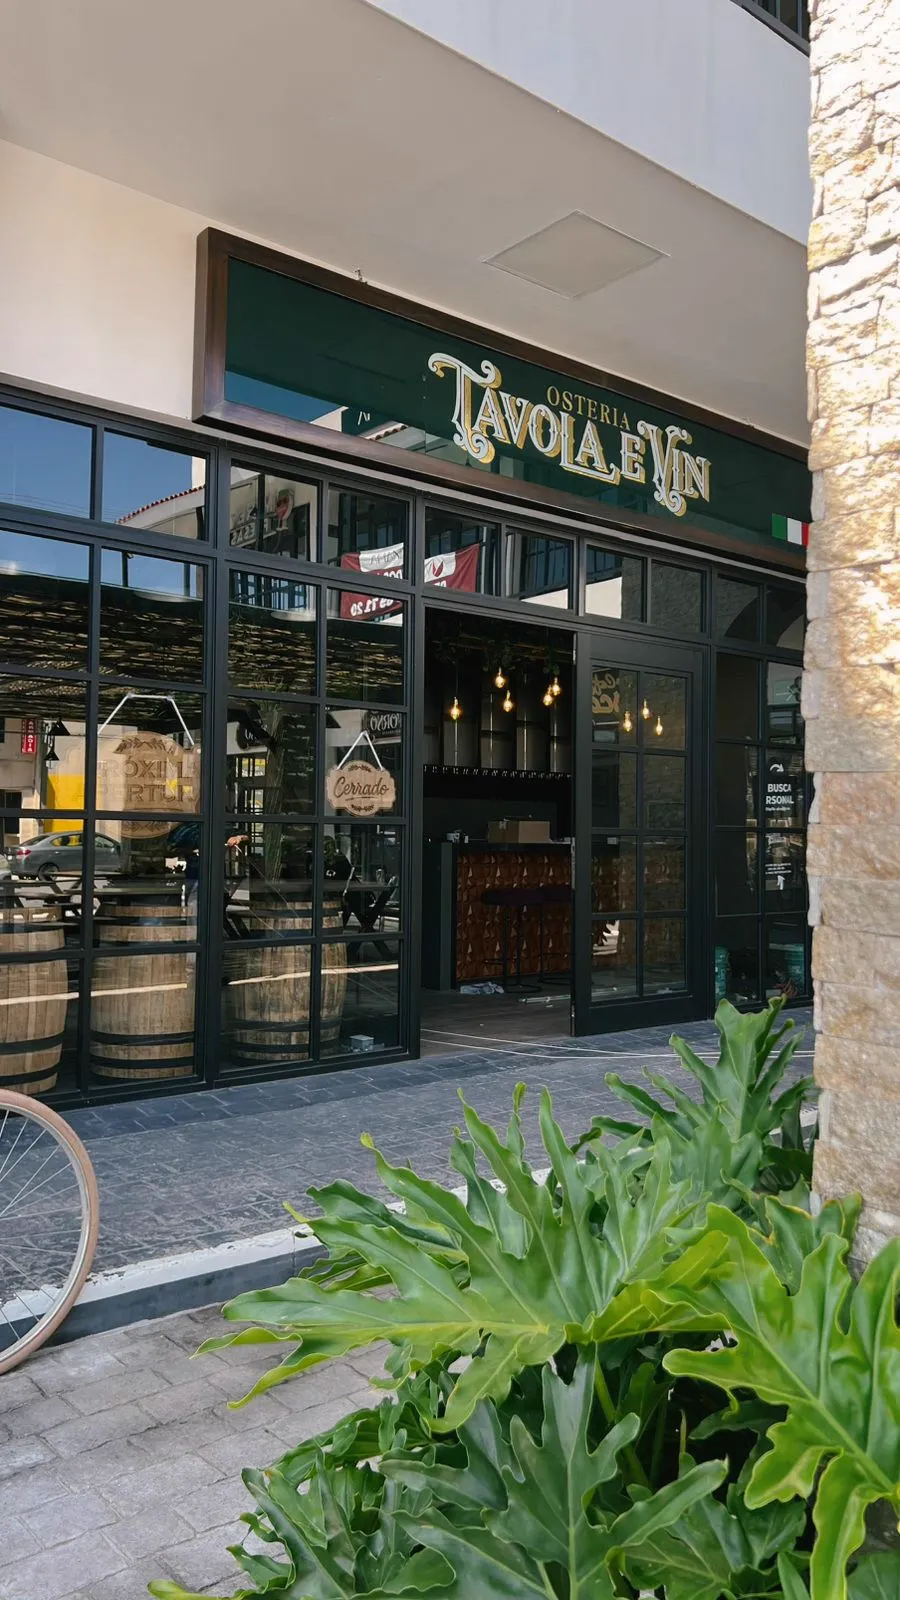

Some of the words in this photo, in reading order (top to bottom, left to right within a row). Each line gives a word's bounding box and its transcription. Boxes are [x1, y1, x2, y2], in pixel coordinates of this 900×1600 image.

[546, 385, 631, 432] OSTERIA
[427, 352, 620, 486] TAVOLA
[619, 430, 646, 484] E
[636, 419, 712, 517] VIN
[333, 776, 390, 799] Cerrado
[767, 783, 792, 793] BUSCA
